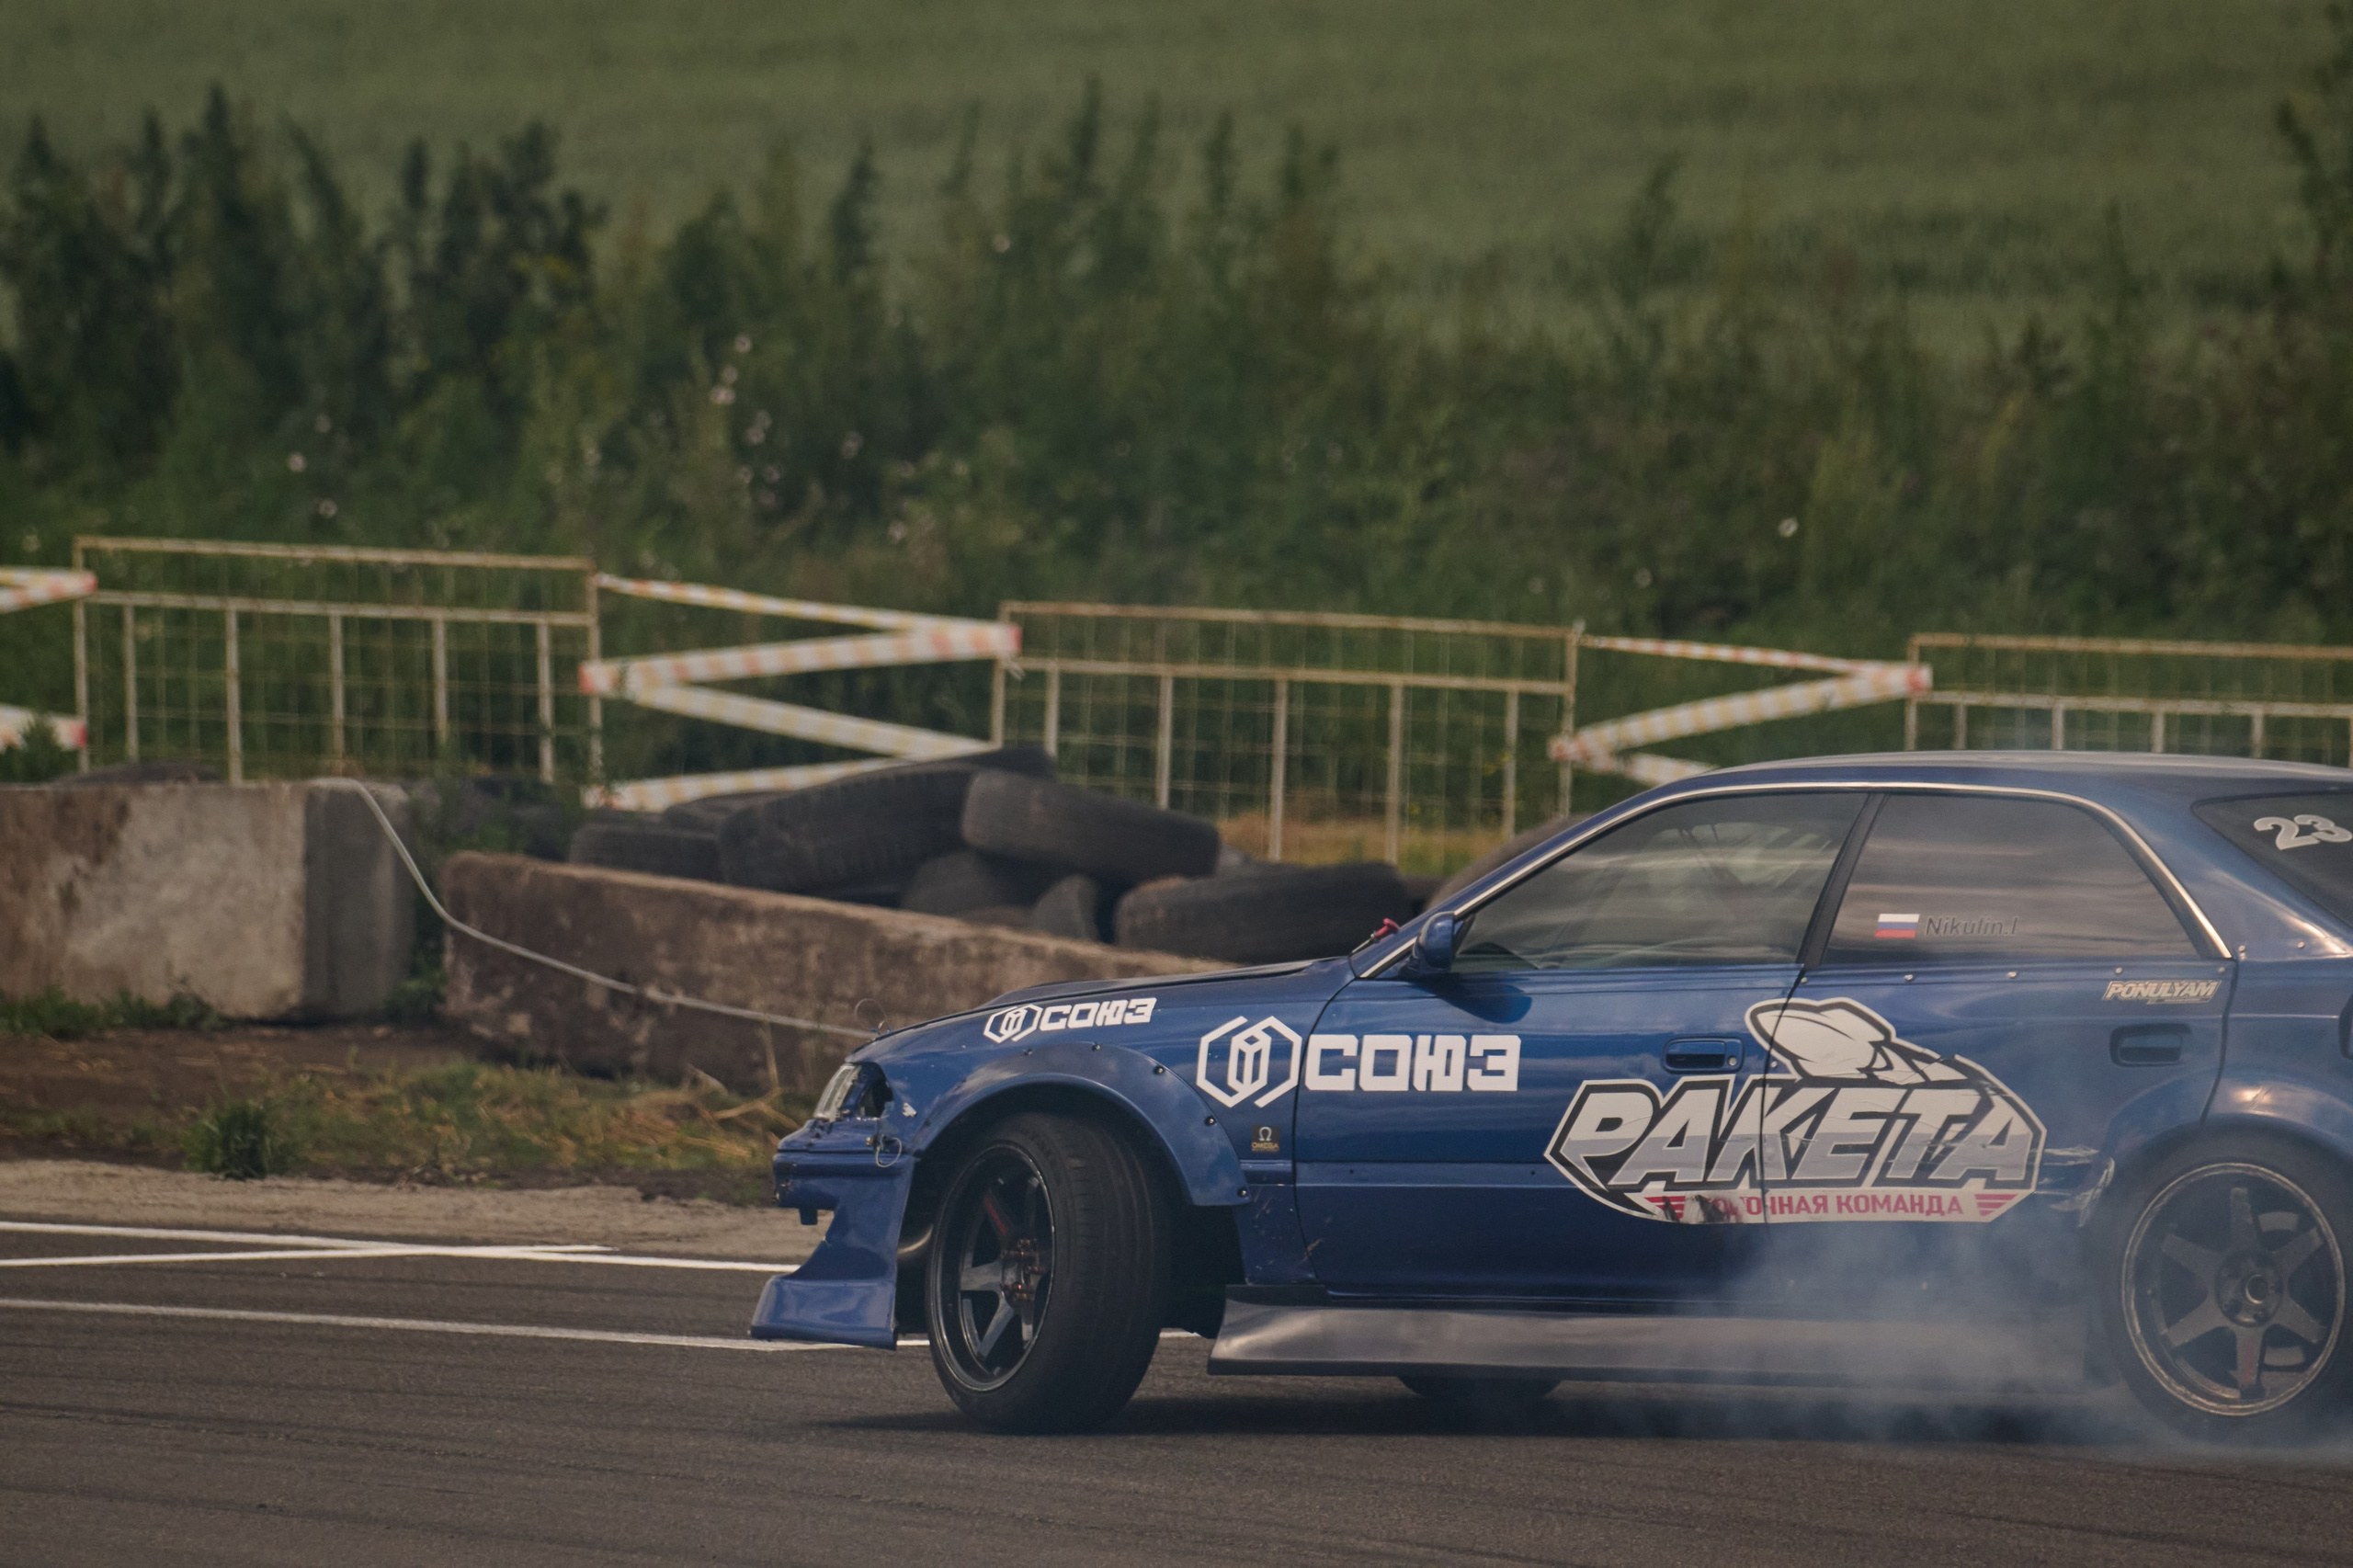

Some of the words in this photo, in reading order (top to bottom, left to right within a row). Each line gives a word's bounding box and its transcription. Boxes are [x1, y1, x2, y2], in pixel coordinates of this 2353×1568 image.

[2254, 814, 2352, 850] 23
[2102, 980, 2222, 1000] PONULYAM
[1040, 997, 1157, 1031] СОЮЗ
[1305, 1035, 1521, 1091] СОЮЗ
[1560, 1087, 2033, 1192] РАКЕТА
[1836, 1194, 1963, 1216] КОМАНДА
